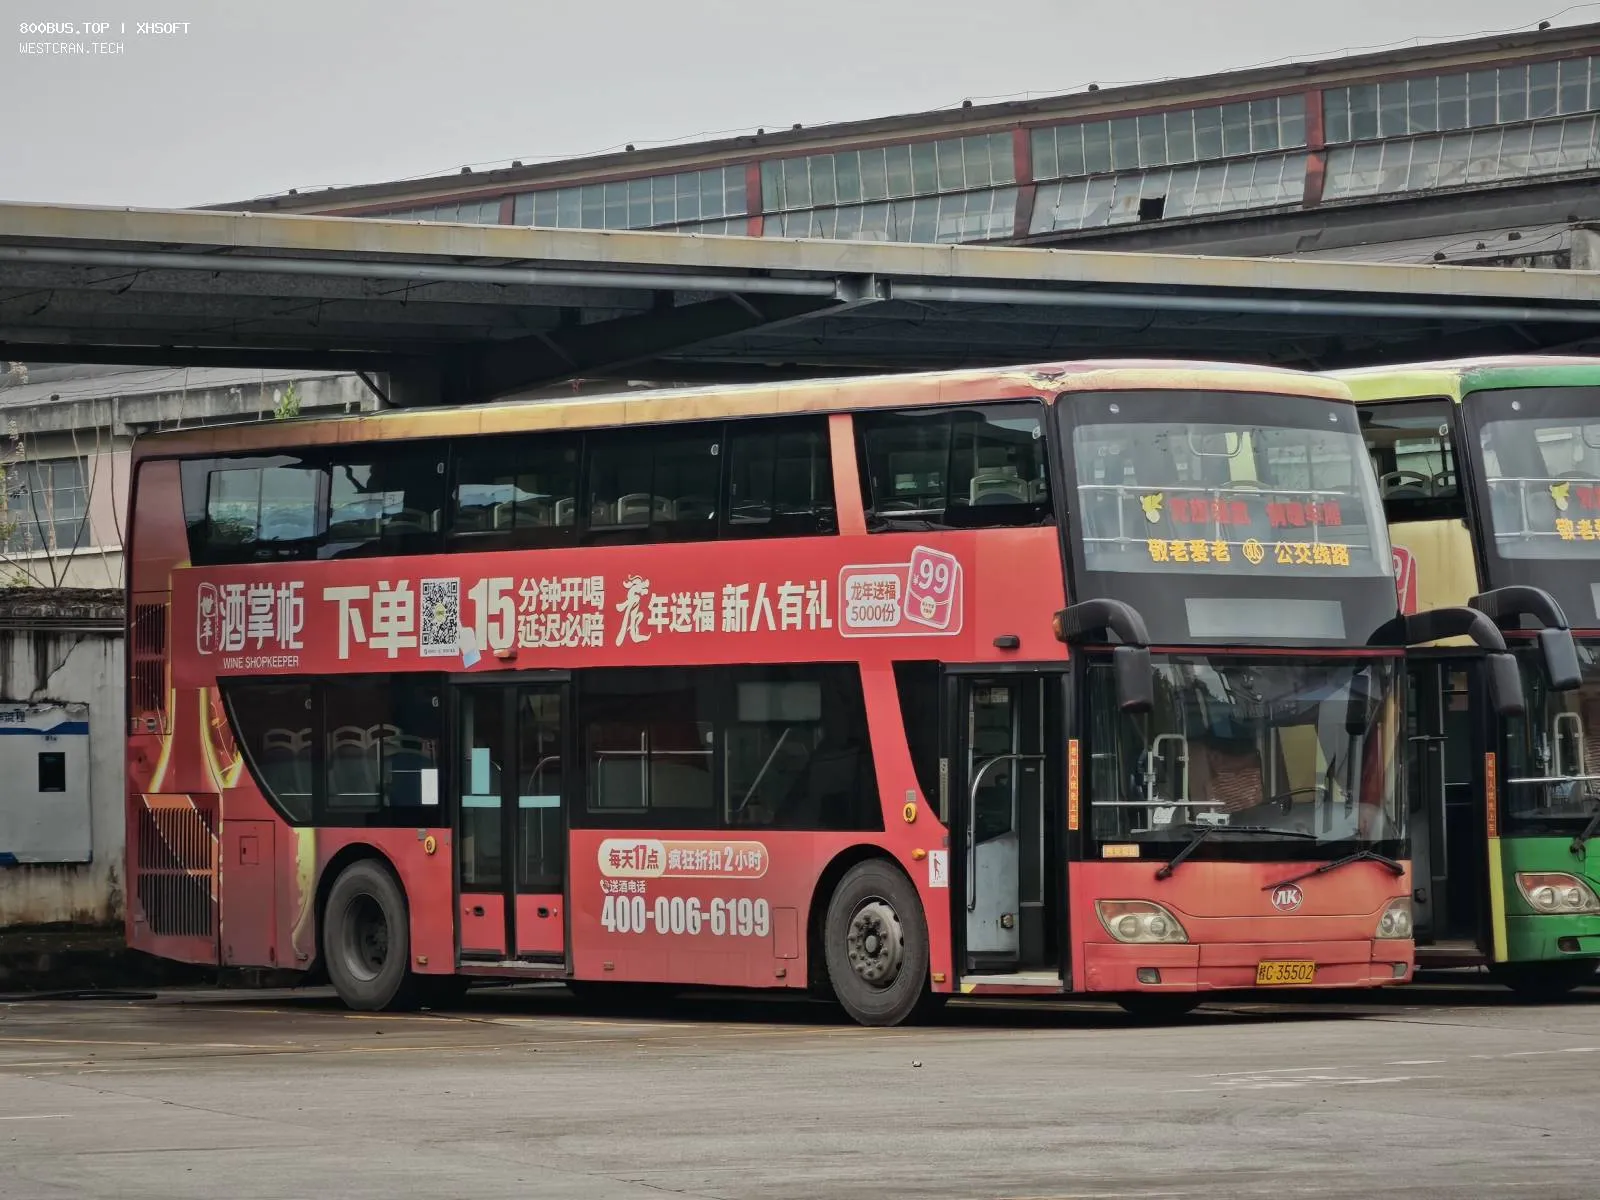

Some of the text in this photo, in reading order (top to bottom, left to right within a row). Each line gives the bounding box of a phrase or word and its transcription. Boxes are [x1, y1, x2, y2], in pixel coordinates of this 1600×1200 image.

[1556, 518, 1600, 541] 敬老
[1148, 538, 1350, 566] 敬老爱老 公交线路
[518, 575, 605, 612] 分钟开喝
[722, 580, 833, 633] 新人有礼
[850, 580, 897, 601] 龙年送福
[219, 580, 305, 652] 酒掌柜
[323, 579, 418, 660] 下单
[468, 577, 516, 650] 15
[850, 603, 896, 623] 5000份
[517, 611, 605, 649] 延迟必赔
[223, 655, 299, 669] WINE SHOPKEEPER
[608, 844, 660, 871] 每天17点
[609, 879, 647, 893] 送酒电话
[601, 895, 770, 937] 400-006-6199
